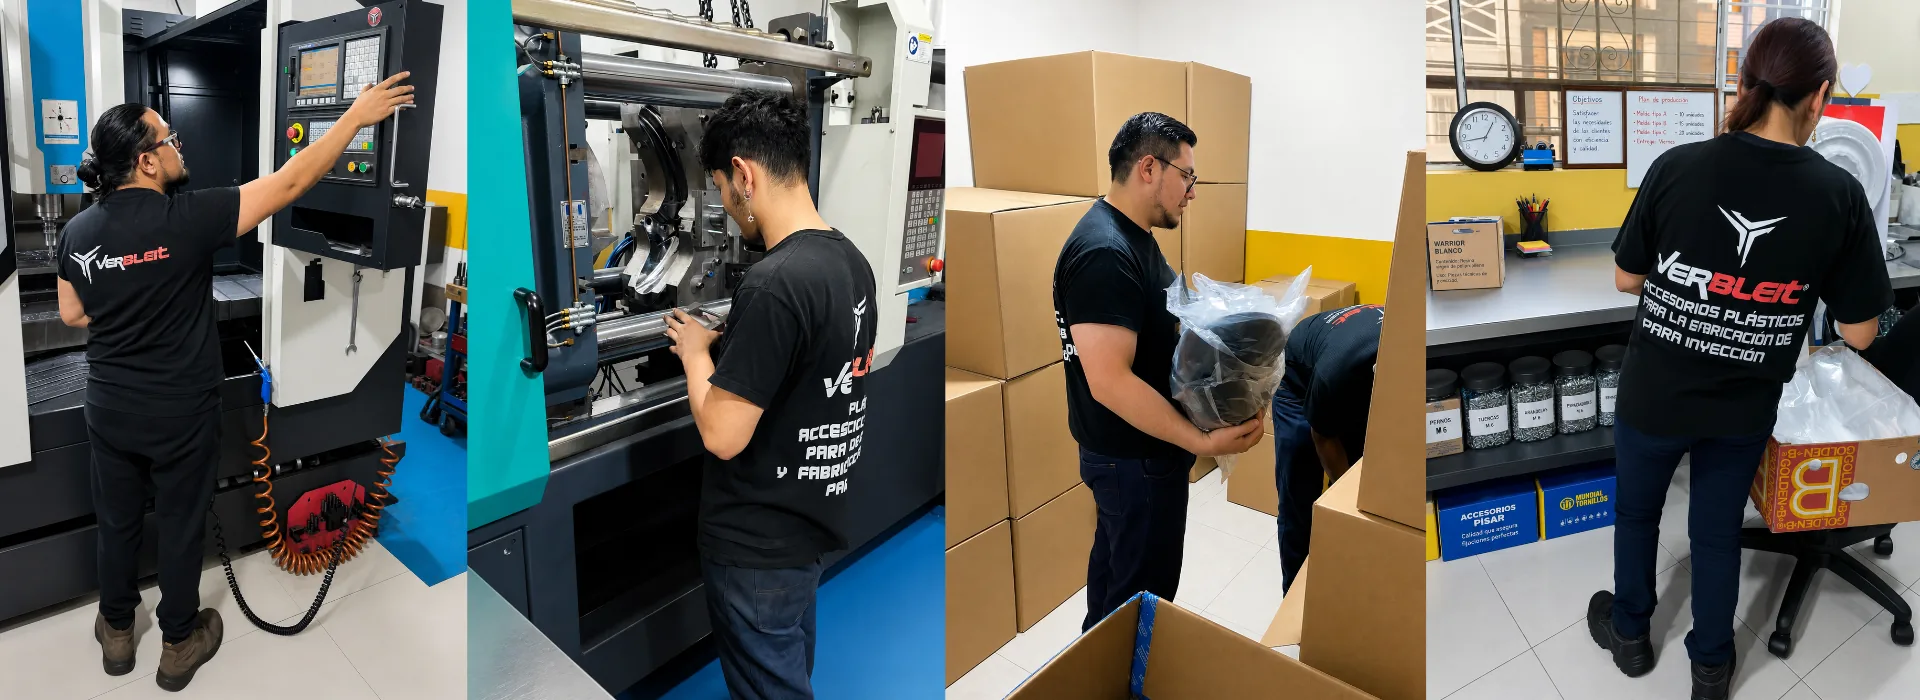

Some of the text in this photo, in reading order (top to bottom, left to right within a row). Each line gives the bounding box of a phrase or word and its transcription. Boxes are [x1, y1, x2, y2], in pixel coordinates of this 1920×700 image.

[1573, 96, 1602, 105] Objetivos
[1573, 110, 1599, 118] Satisfacer
[1644, 279, 1805, 327] ACCESORIOS PLÁSTICOS
[1643, 318, 1682, 344] PARA
[1669, 311, 1687, 328] LA
[1775, 333, 1792, 346] DE
[806, 442, 846, 460] PARA
[1576, 490, 1603, 500] MUNDIAL
[1576, 495, 1608, 507] TORNILLOS
[1461, 504, 1516, 521] ACCESORIOS
[1474, 514, 1504, 527] PISAR
[1462, 530, 1483, 539] Calidad
[1496, 524, 1517, 532] asegura
[1491, 531, 1518, 541] perfectas
